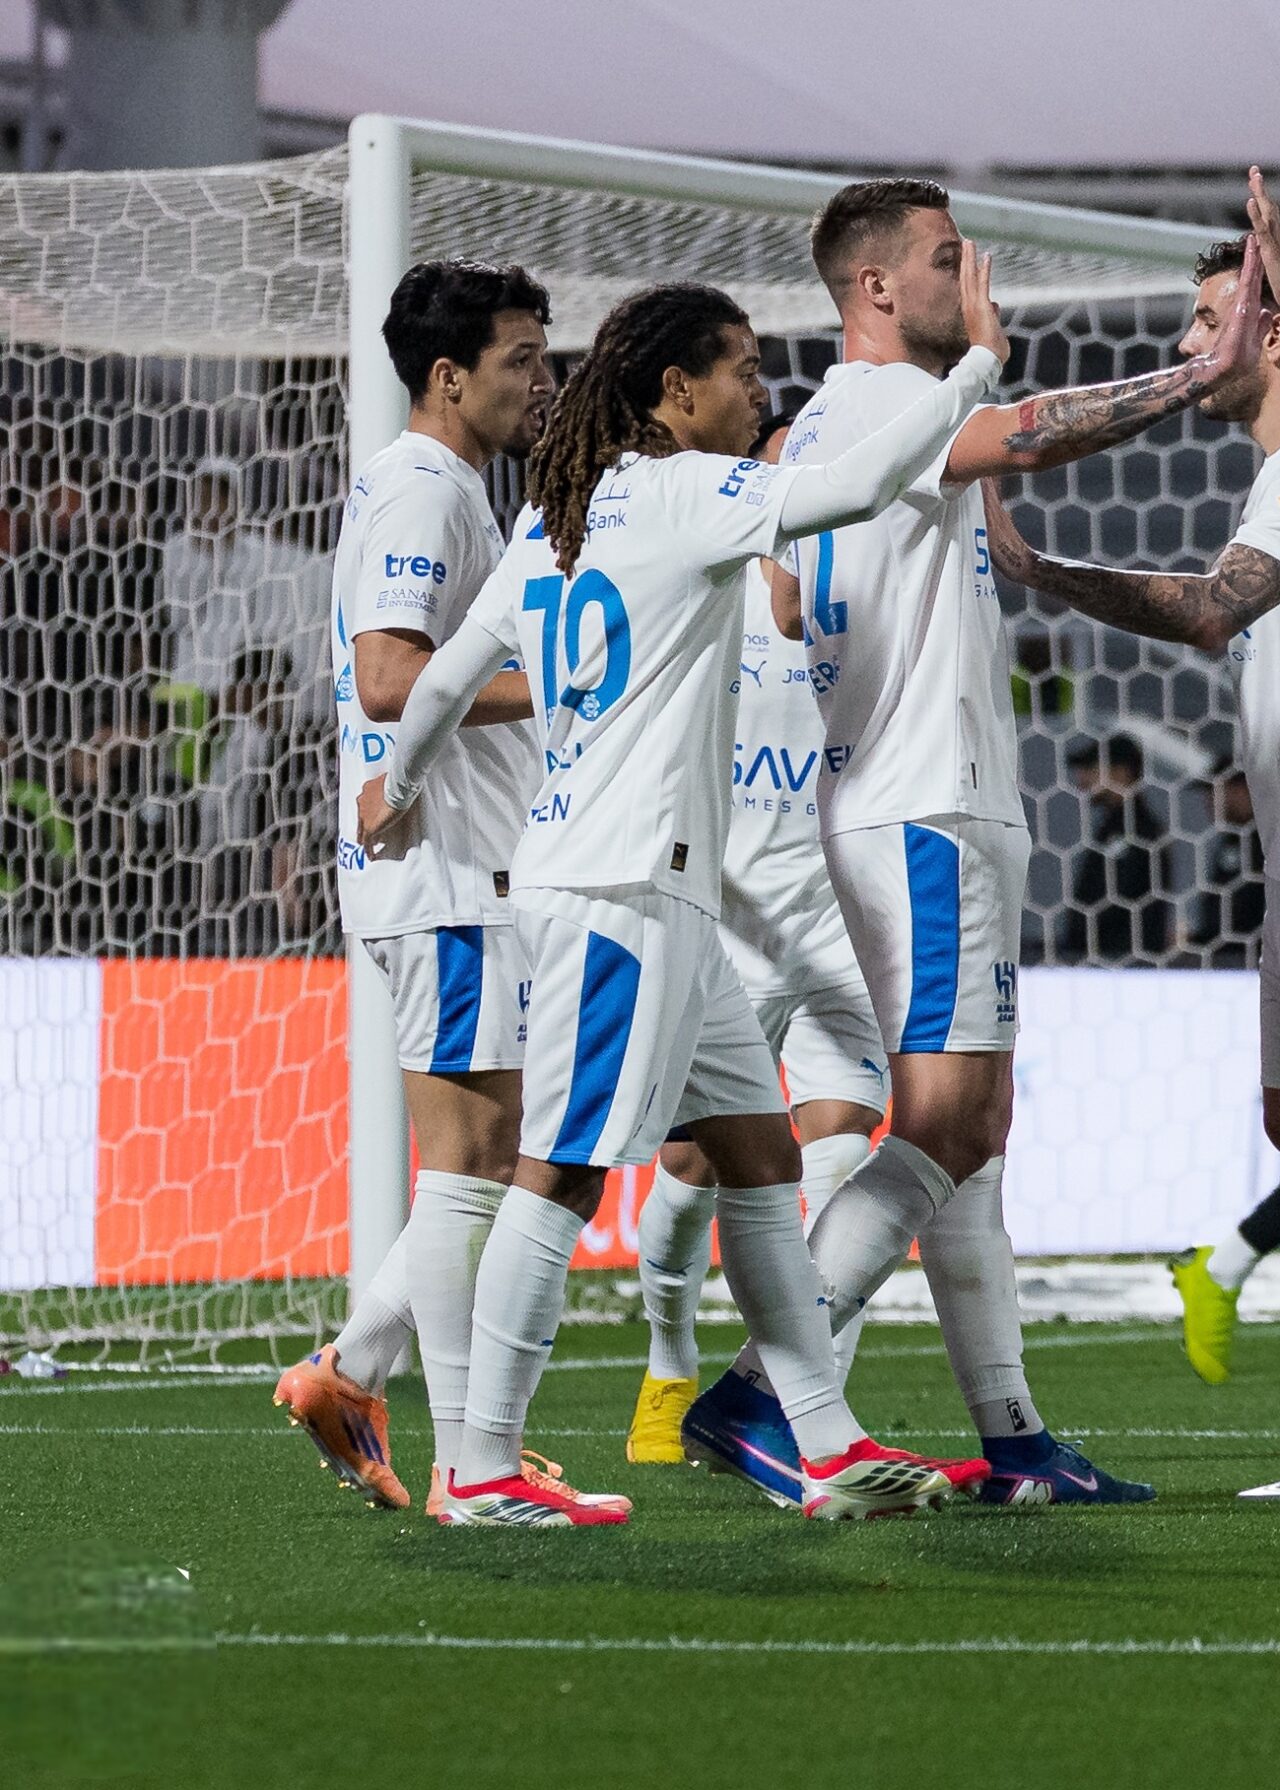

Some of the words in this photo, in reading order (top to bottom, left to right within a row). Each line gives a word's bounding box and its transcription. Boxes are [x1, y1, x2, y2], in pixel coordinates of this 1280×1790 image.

[718, 460, 761, 498] tre
[384, 553, 447, 585] tree
[522, 567, 632, 733] 10
[743, 634, 769, 645] nas
[744, 796, 792, 814] MES
